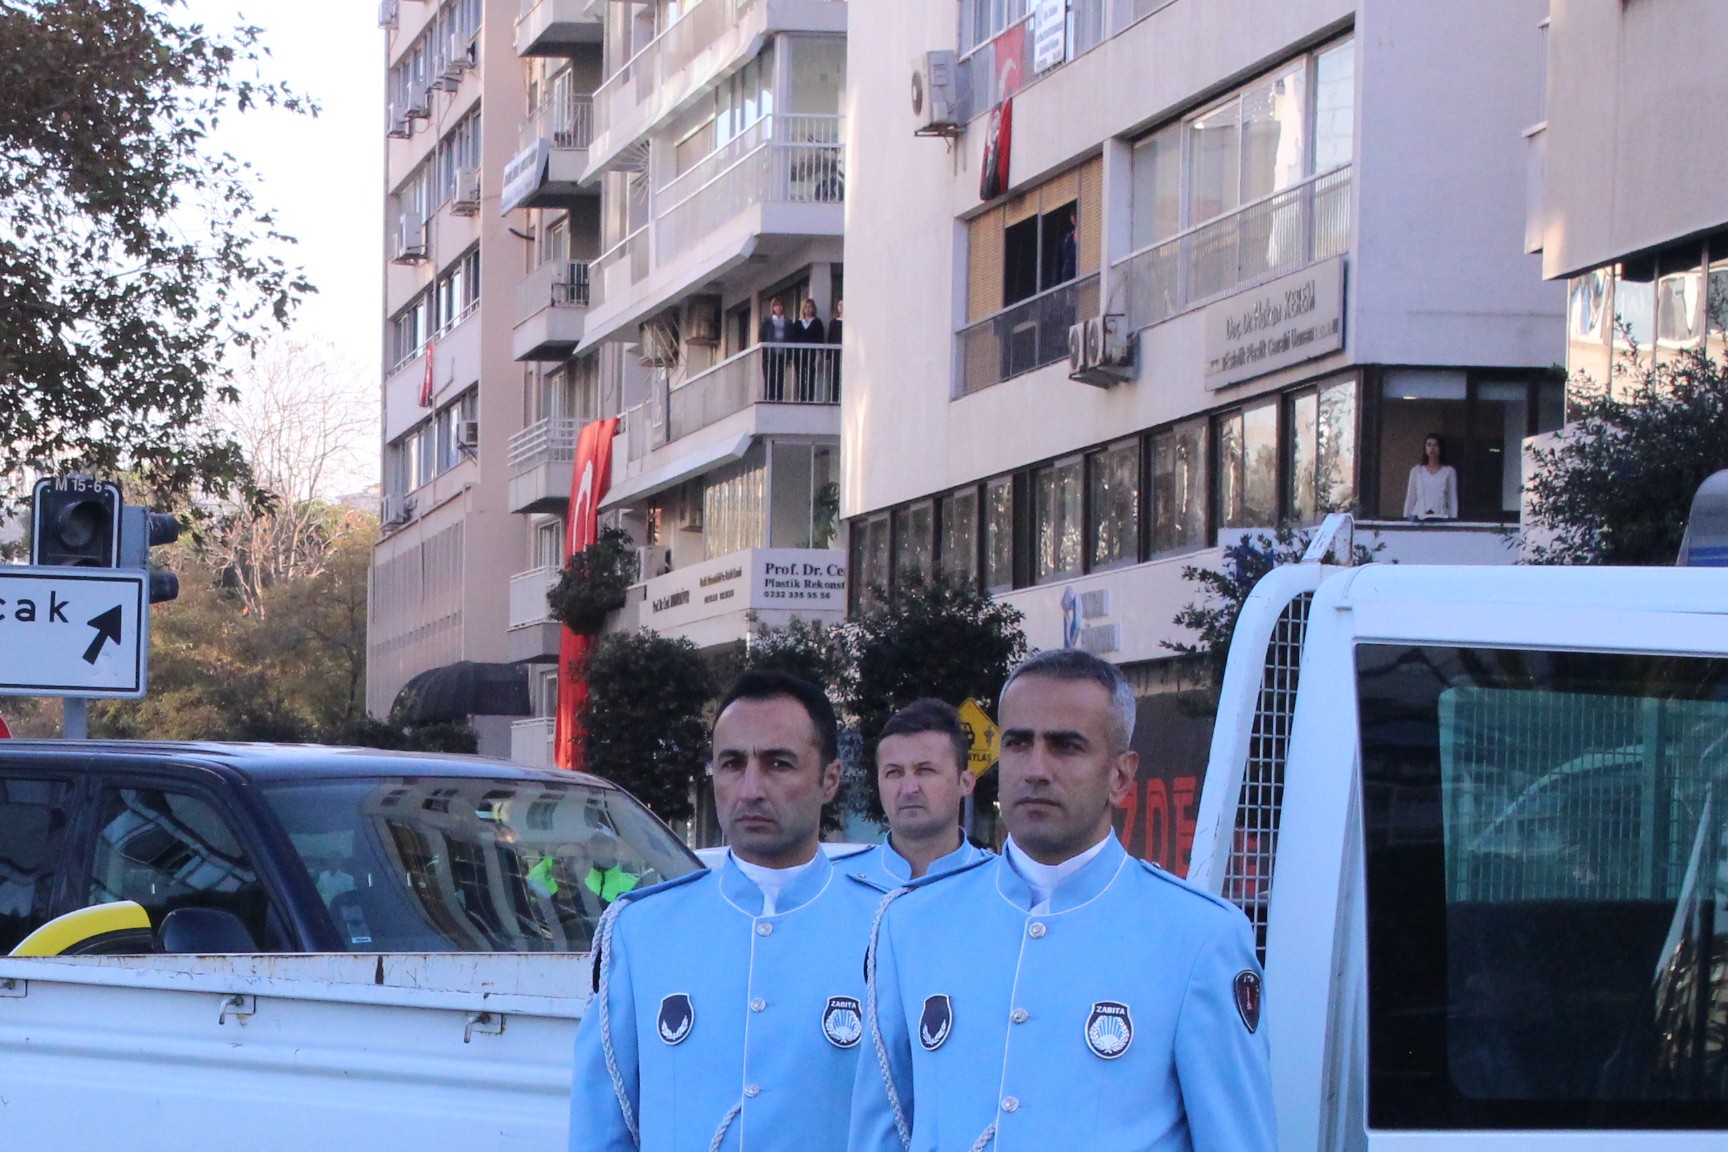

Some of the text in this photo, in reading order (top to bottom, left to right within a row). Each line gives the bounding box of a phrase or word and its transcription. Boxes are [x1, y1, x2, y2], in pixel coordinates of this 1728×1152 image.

[765, 562, 799, 576] Prof.
[803, 563, 823, 576] Dr.
[764, 578, 800, 588] Plastik
[1095, 1005, 1125, 1015] ZABITA
